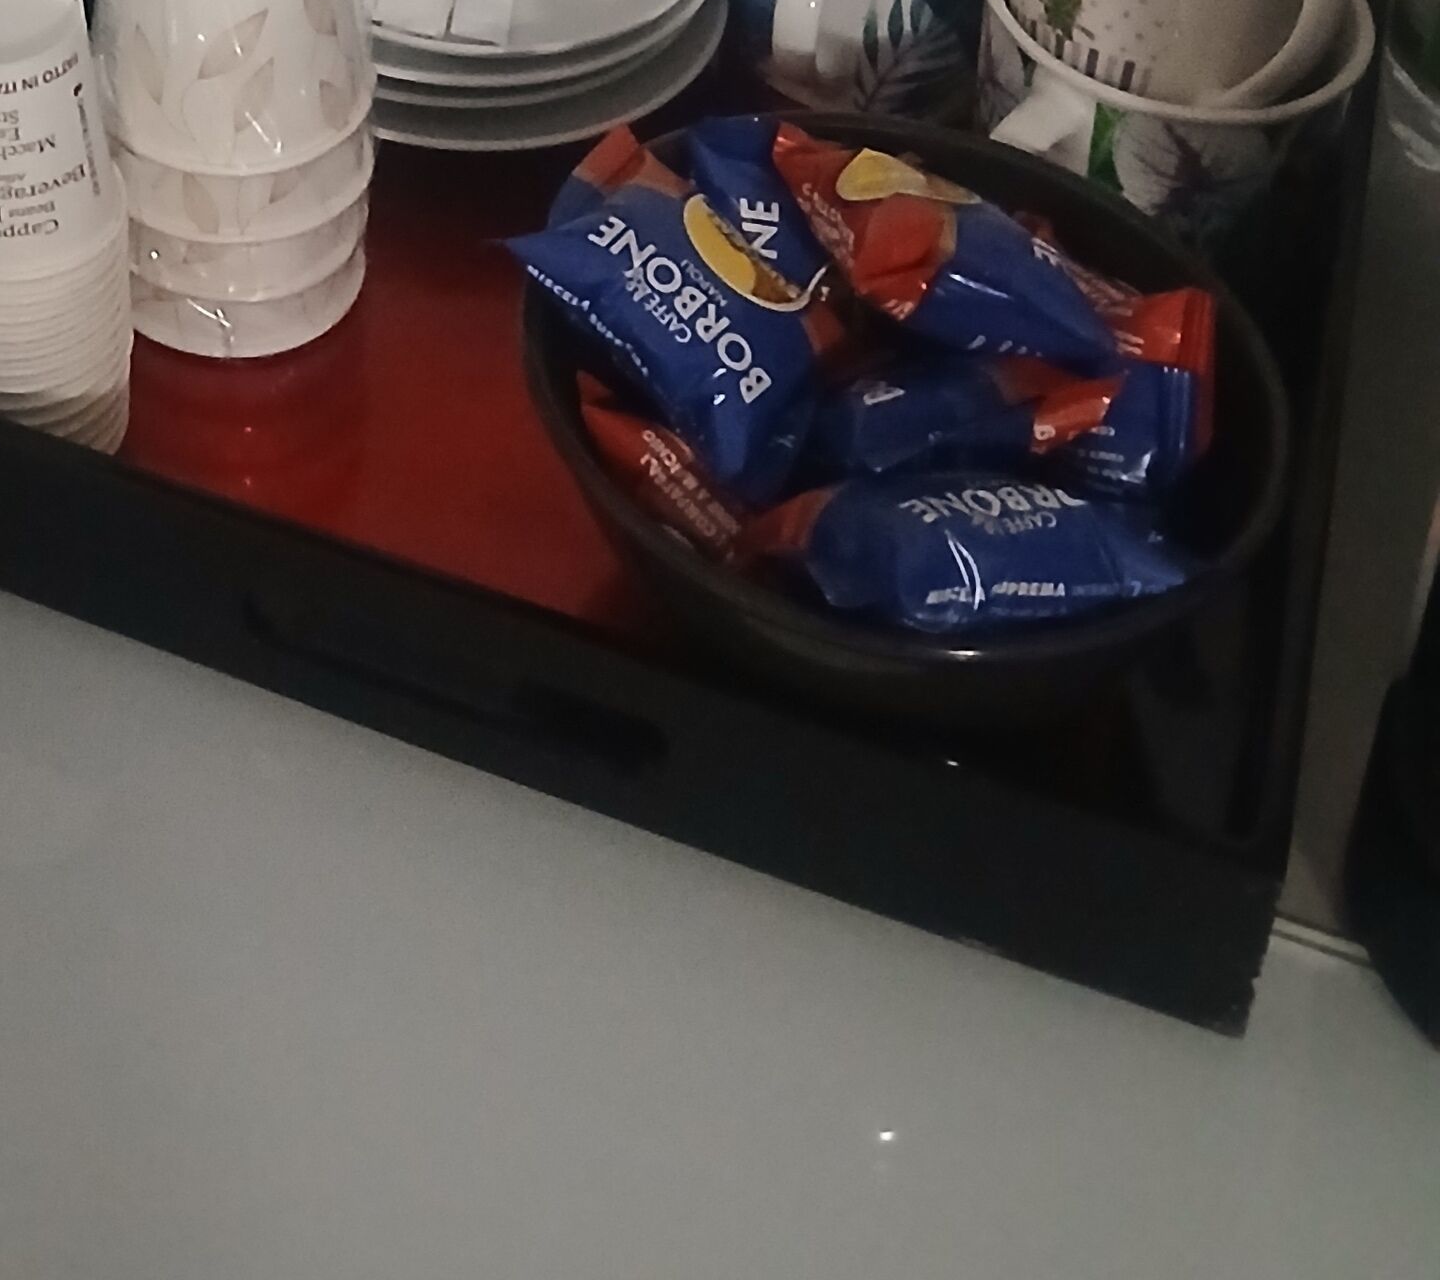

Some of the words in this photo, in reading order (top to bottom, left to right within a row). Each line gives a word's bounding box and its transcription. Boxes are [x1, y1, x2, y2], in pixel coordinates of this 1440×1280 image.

[22, 76, 39, 90] IN
[681, 259, 728, 307] NAPOLI
[587, 216, 772, 404] BORBONE
[899, 484, 1088, 523] RBONE
